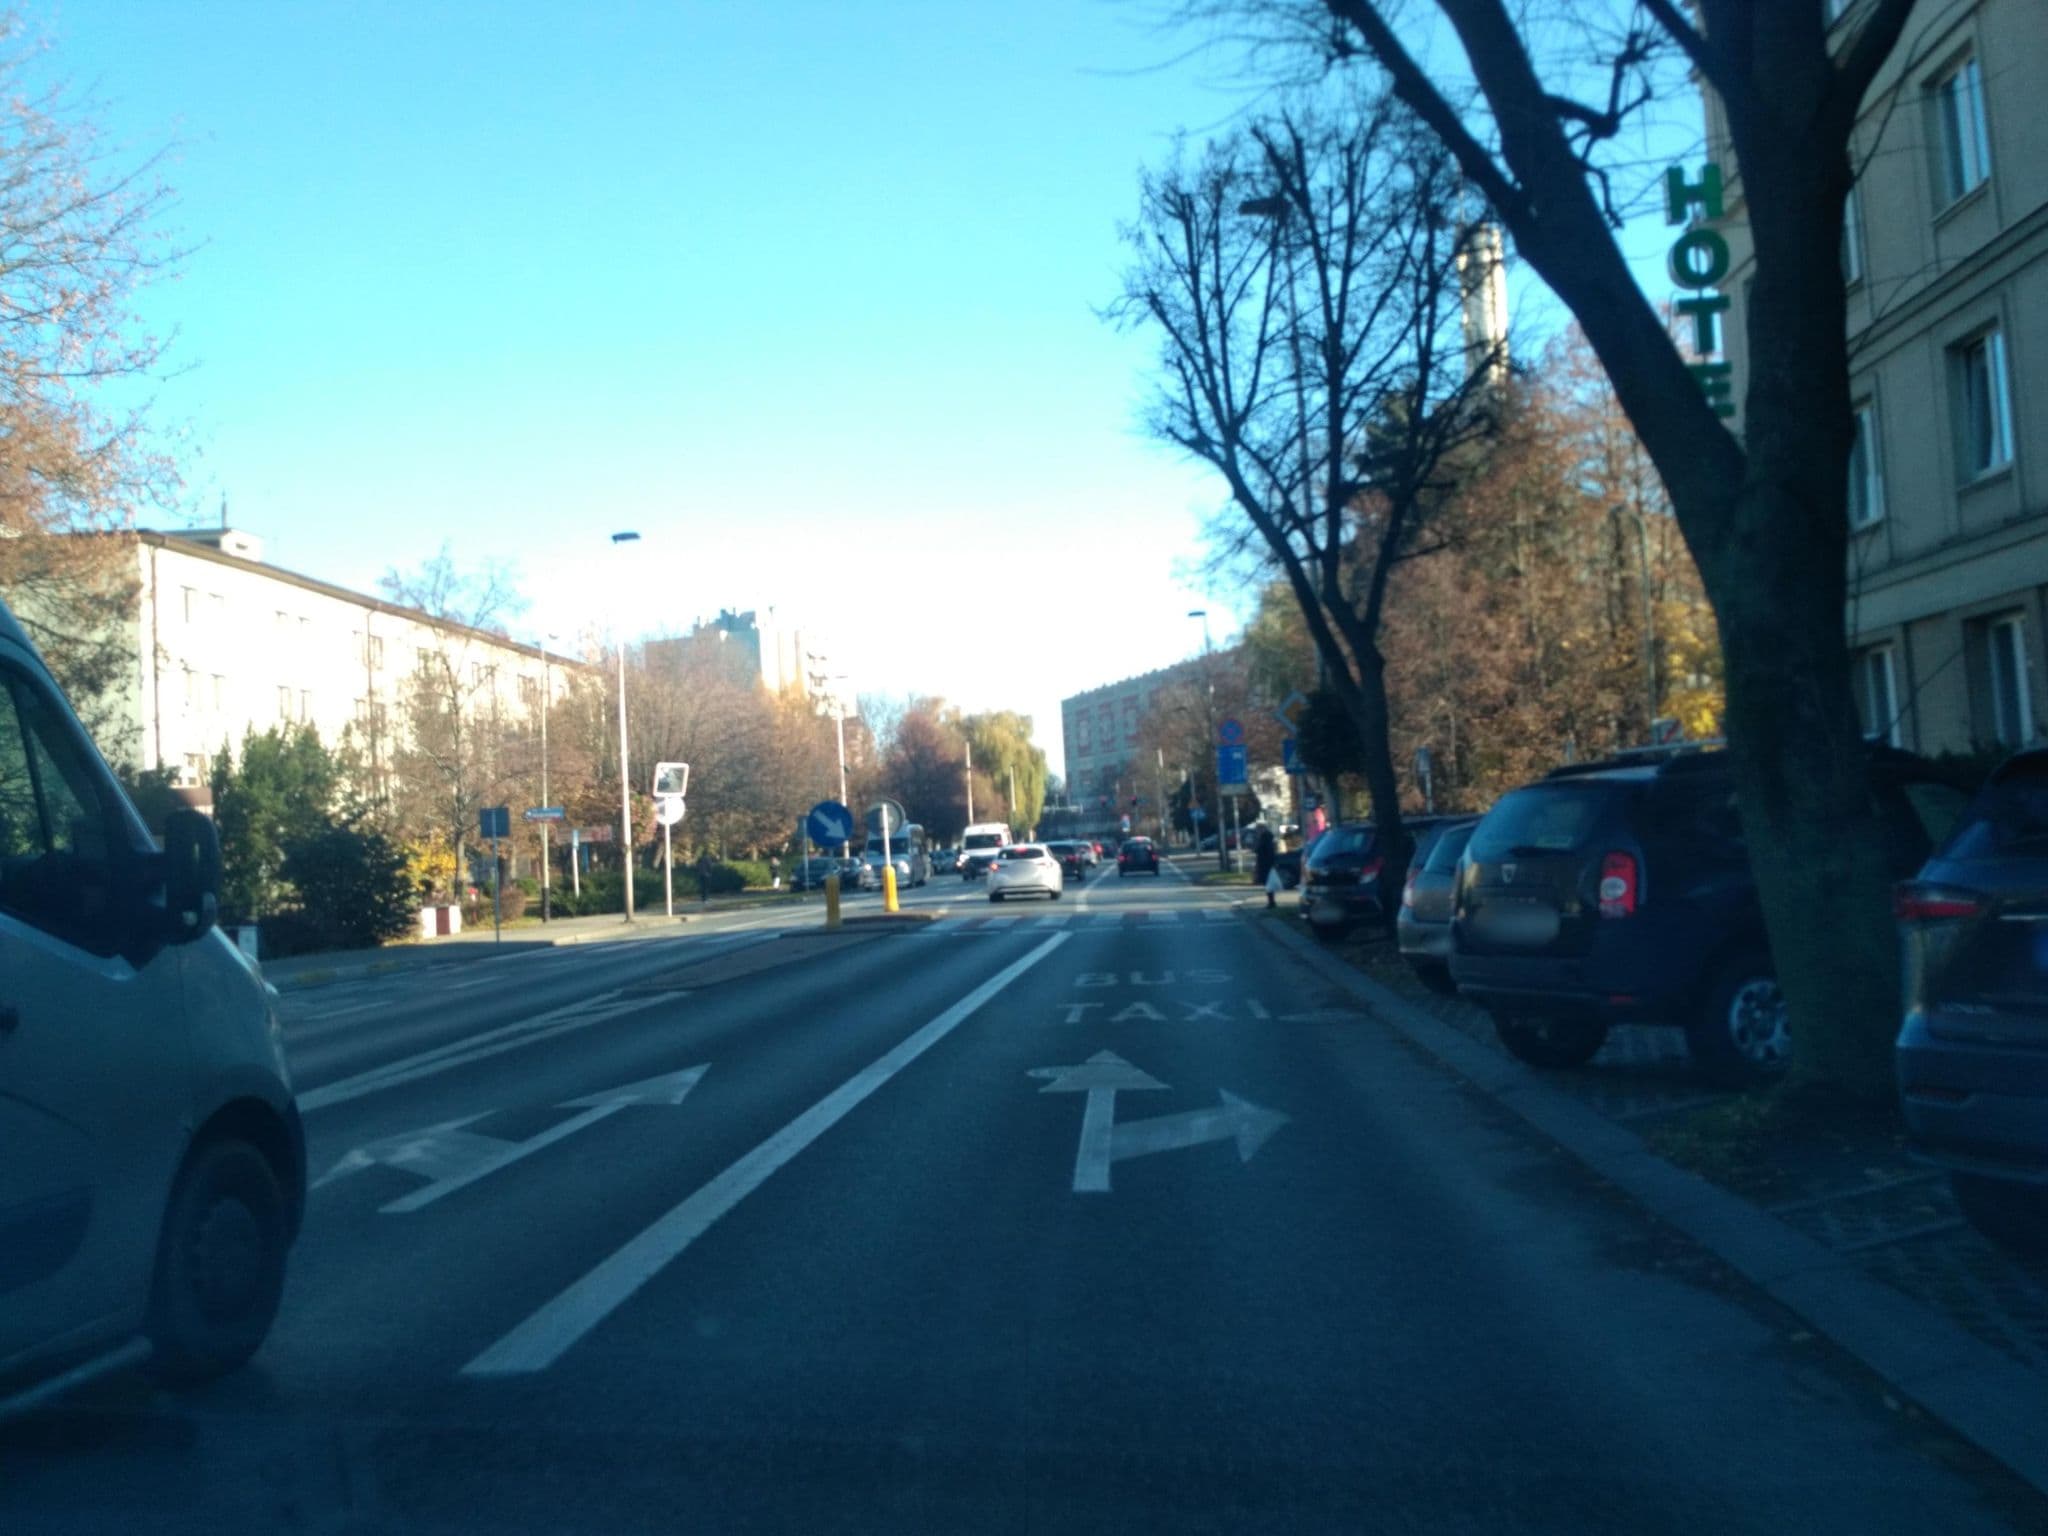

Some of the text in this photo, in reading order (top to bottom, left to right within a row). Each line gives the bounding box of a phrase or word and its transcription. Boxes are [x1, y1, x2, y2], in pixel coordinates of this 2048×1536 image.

[1667, 164, 1735, 417] HOTE
[1073, 970, 1234, 986] BUS
[1056, 999, 1270, 1024] TAXI
